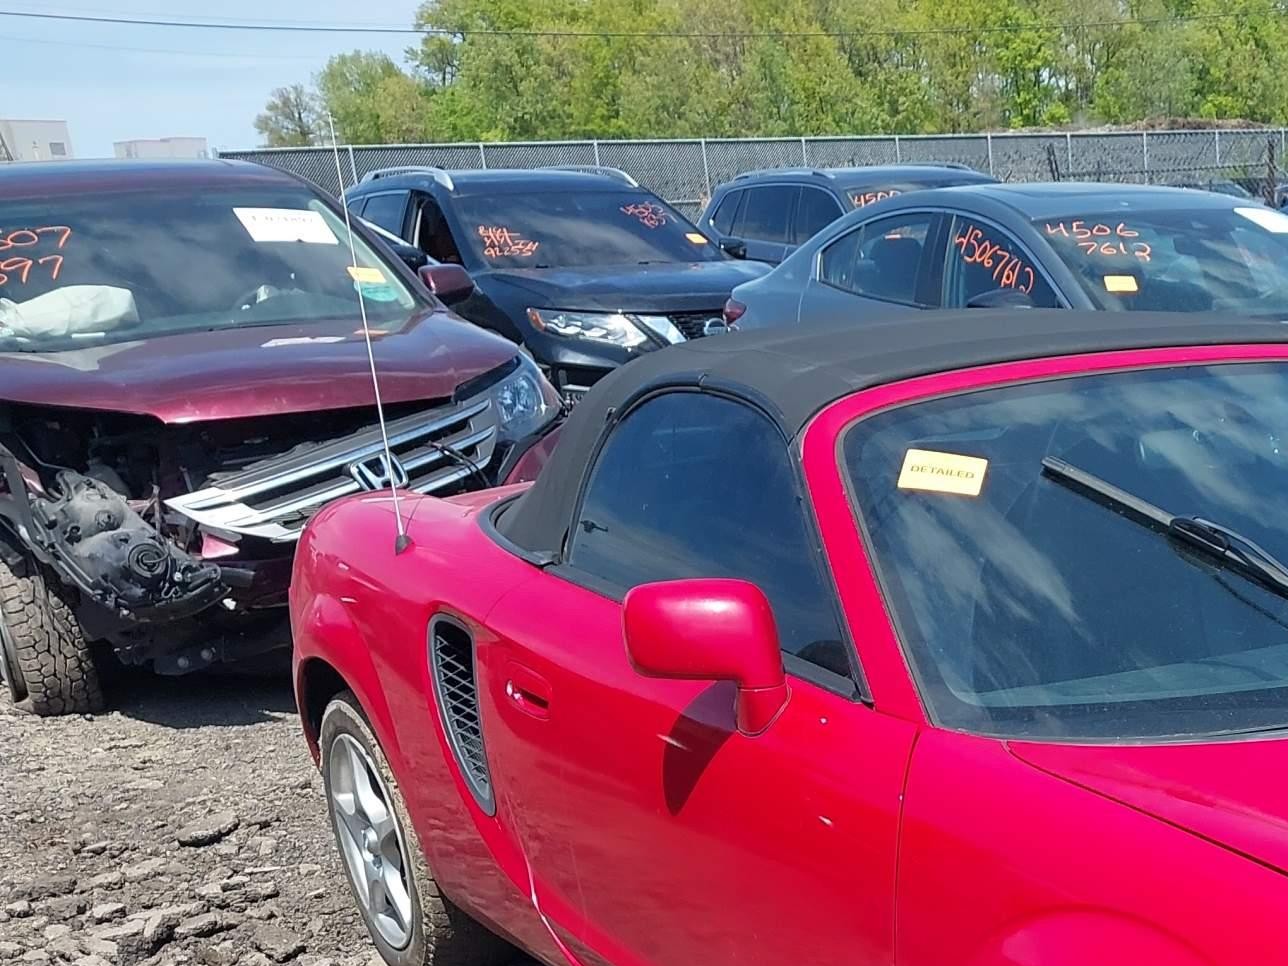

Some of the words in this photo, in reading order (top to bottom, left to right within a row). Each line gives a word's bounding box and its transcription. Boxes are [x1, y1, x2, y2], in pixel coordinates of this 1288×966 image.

[1045, 220, 1139, 239] 4506
[1077, 241, 1153, 262] 7612
[909, 463, 976, 480] DETAILED
